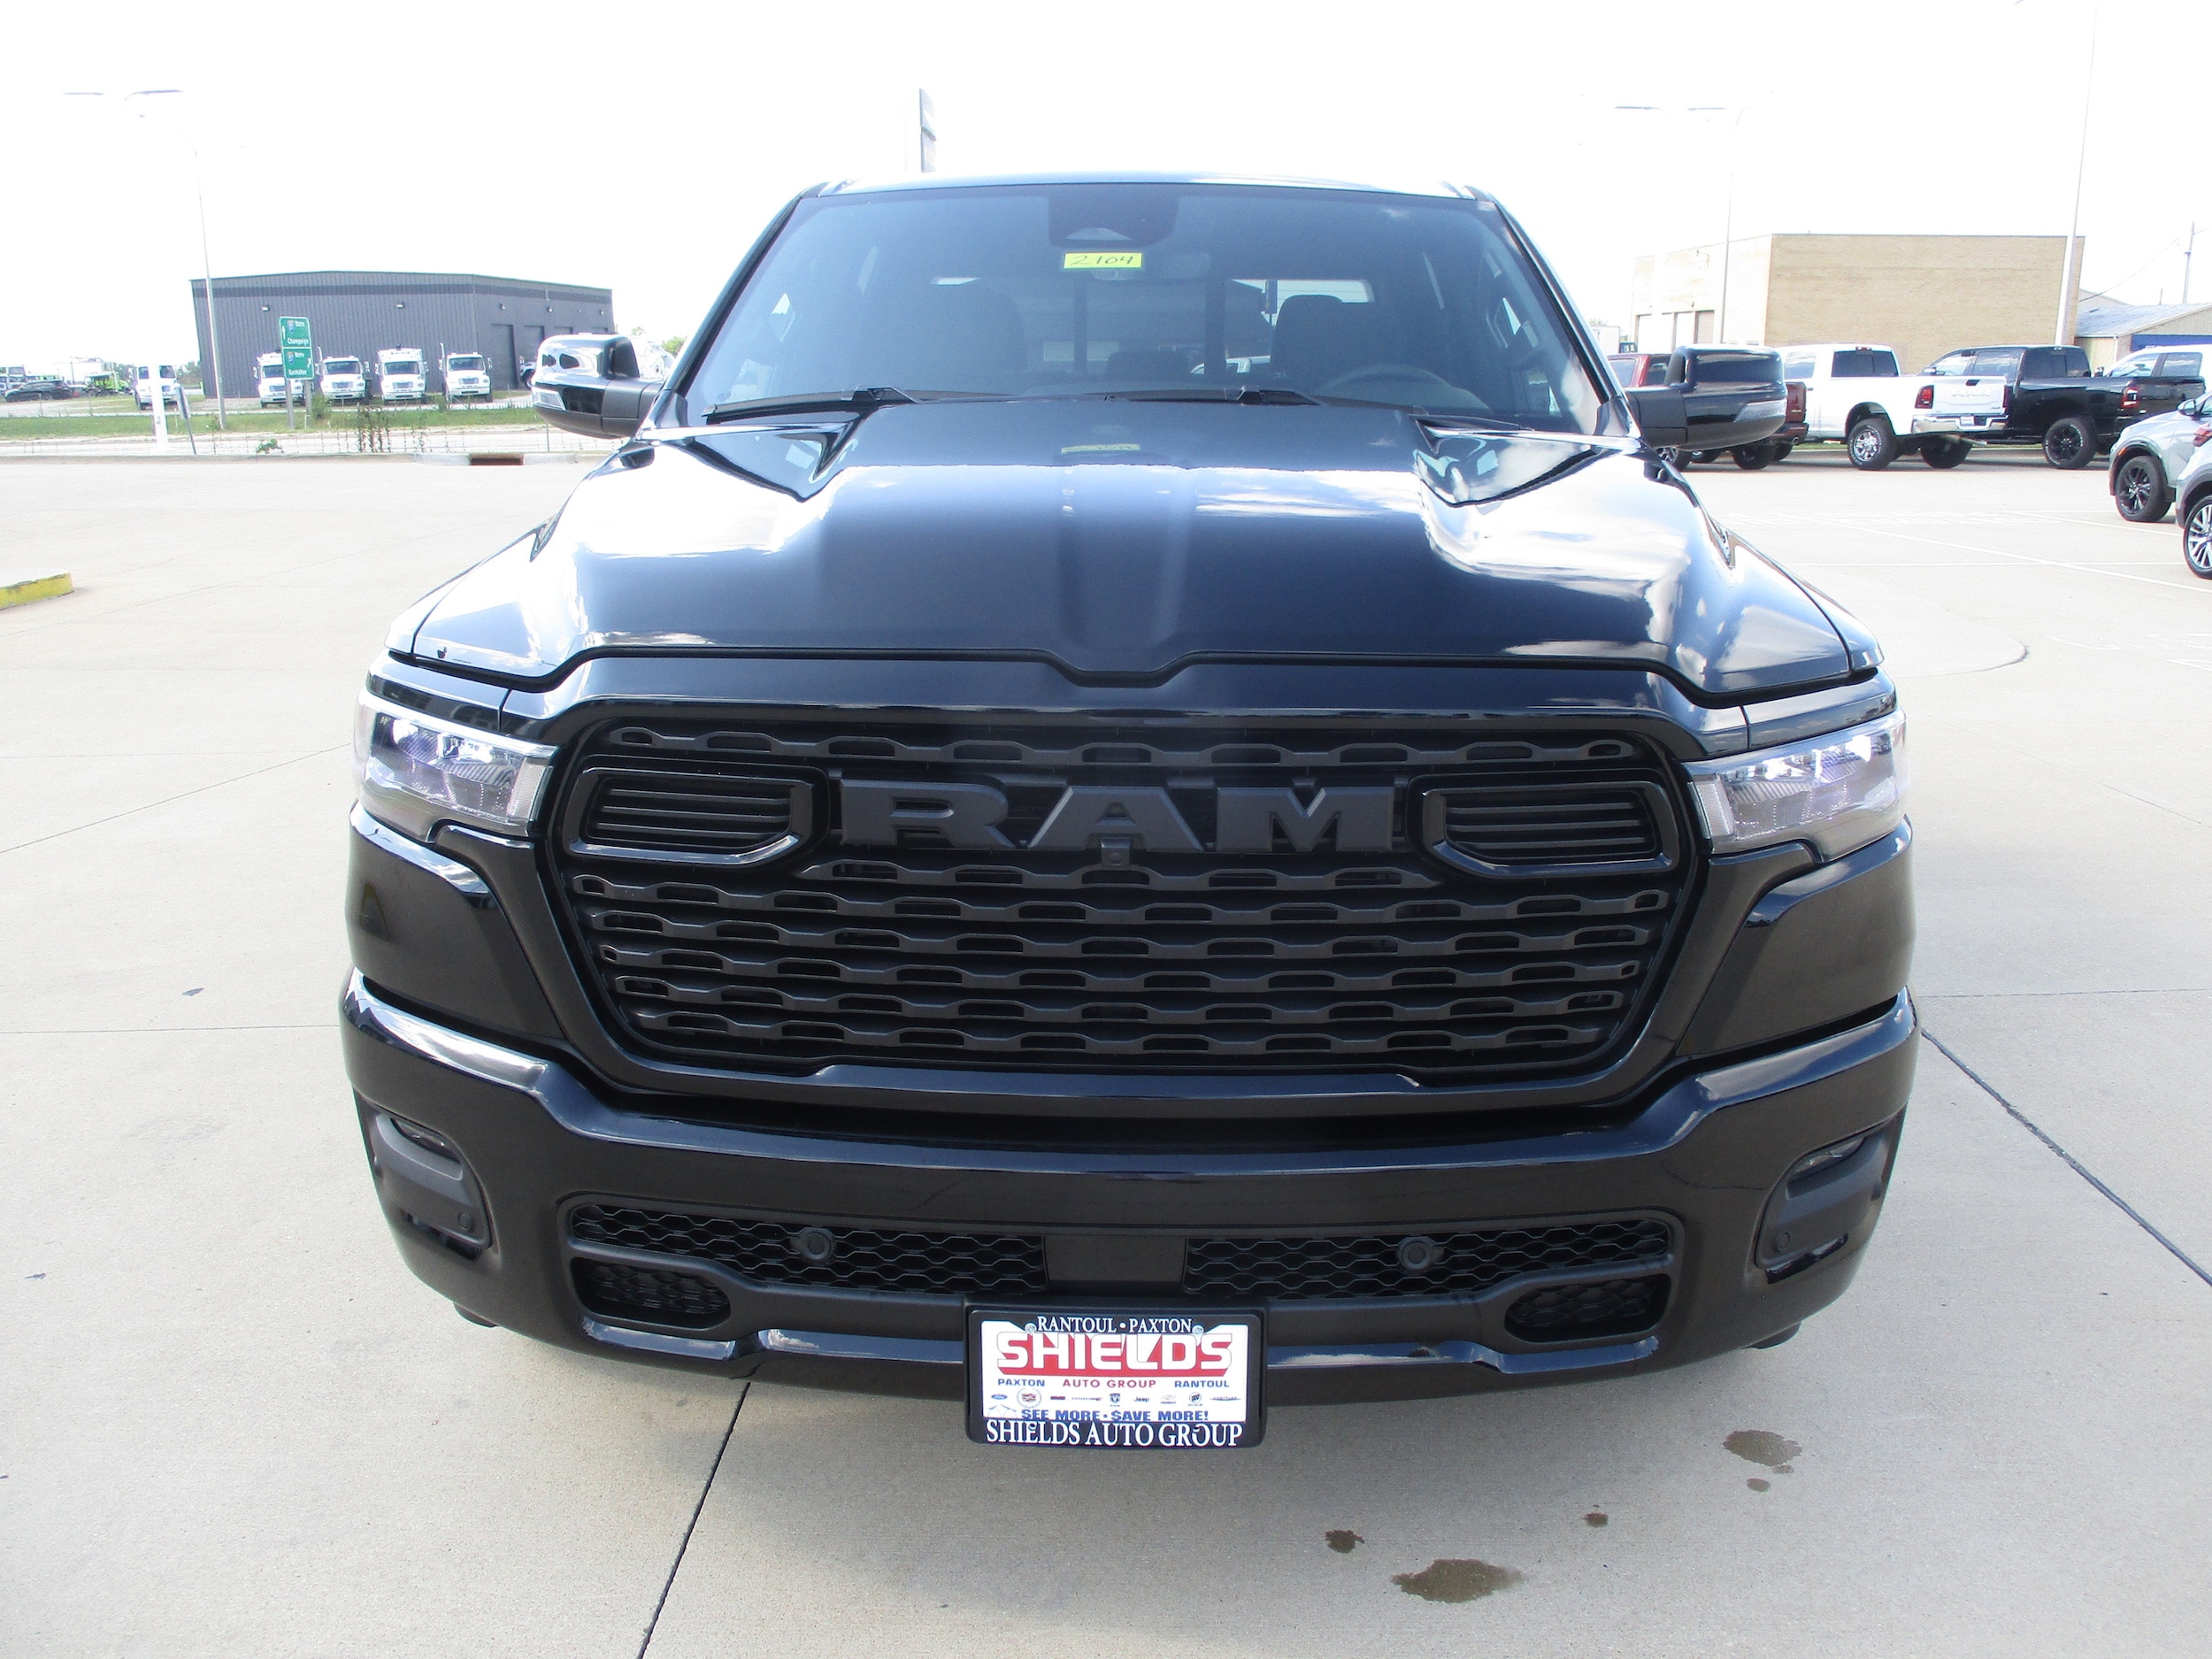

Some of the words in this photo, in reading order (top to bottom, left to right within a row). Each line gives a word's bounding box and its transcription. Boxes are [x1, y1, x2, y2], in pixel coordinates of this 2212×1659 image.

[1069, 255, 1133, 266] 2104
[840, 778, 1394, 853] RAM
[1037, 1316, 1117, 1333] RANTOUL
[1128, 1317, 1192, 1333] PAXTON
[996, 1331, 1233, 1375] SHIELDS
[1063, 1379, 1100, 1387] AUTO
[1107, 1379, 1156, 1388] GROUP
[1021, 1409, 1049, 1420] SEE
[1055, 1410, 1100, 1420] MORE
[1157, 1410, 1209, 1421] MORE!
[986, 1418, 1081, 1445] SHIELDS
[1085, 1421, 1155, 1446] AUTO
[1158, 1423, 1243, 1447] GROUP
